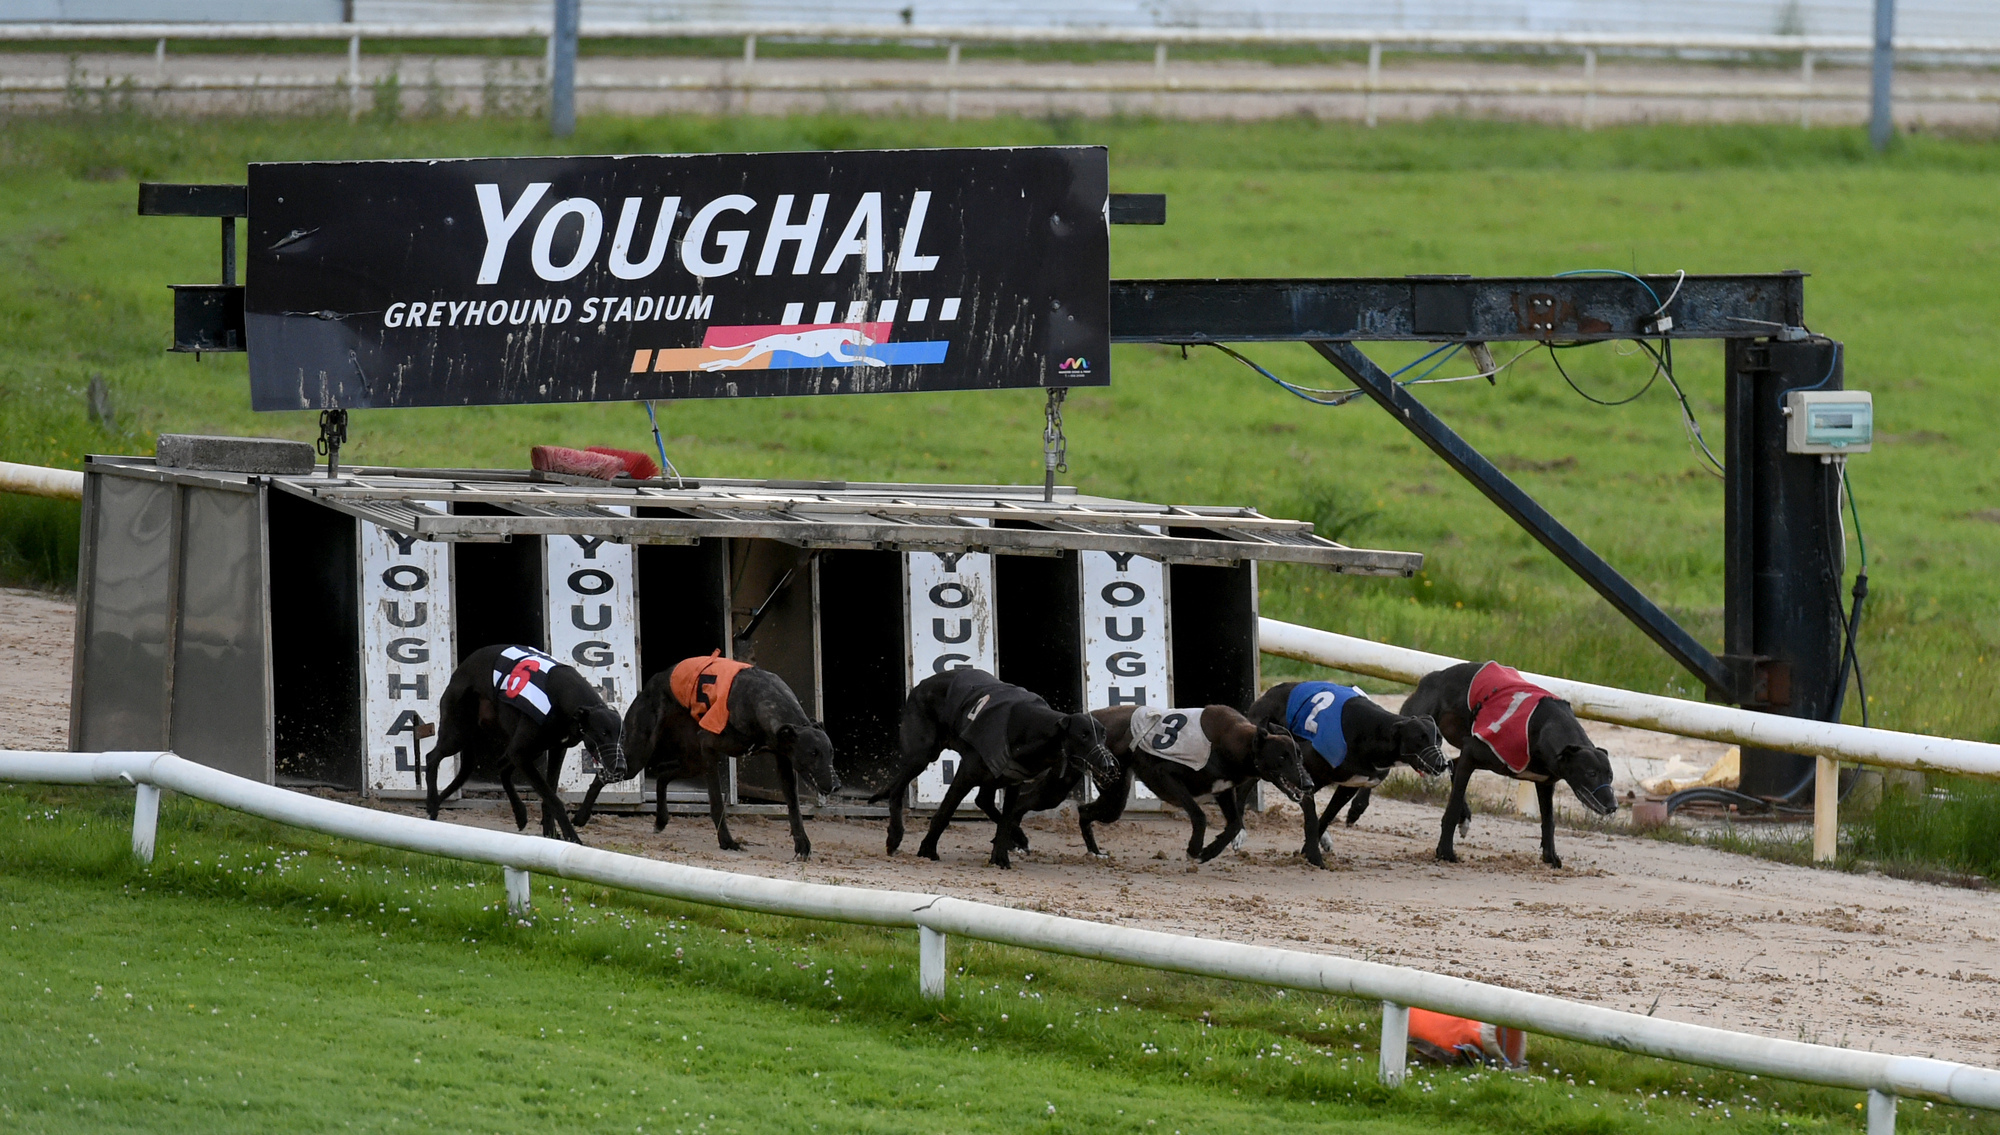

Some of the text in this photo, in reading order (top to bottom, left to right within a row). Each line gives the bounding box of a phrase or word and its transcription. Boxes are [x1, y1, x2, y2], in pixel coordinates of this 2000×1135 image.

[475, 182, 940, 284] YOUGHAL
[384, 295, 714, 328] GREYHOUND STADIUM
[1101, 551, 1147, 706] YOUGH
[383, 528, 430, 772] YOUGHAL
[505, 659, 540, 699] 6
[696, 673, 718, 717] 5
[1152, 713, 1188, 750] 3
[1305, 691, 1335, 733] 2
[1487, 691, 1532, 733] 1
